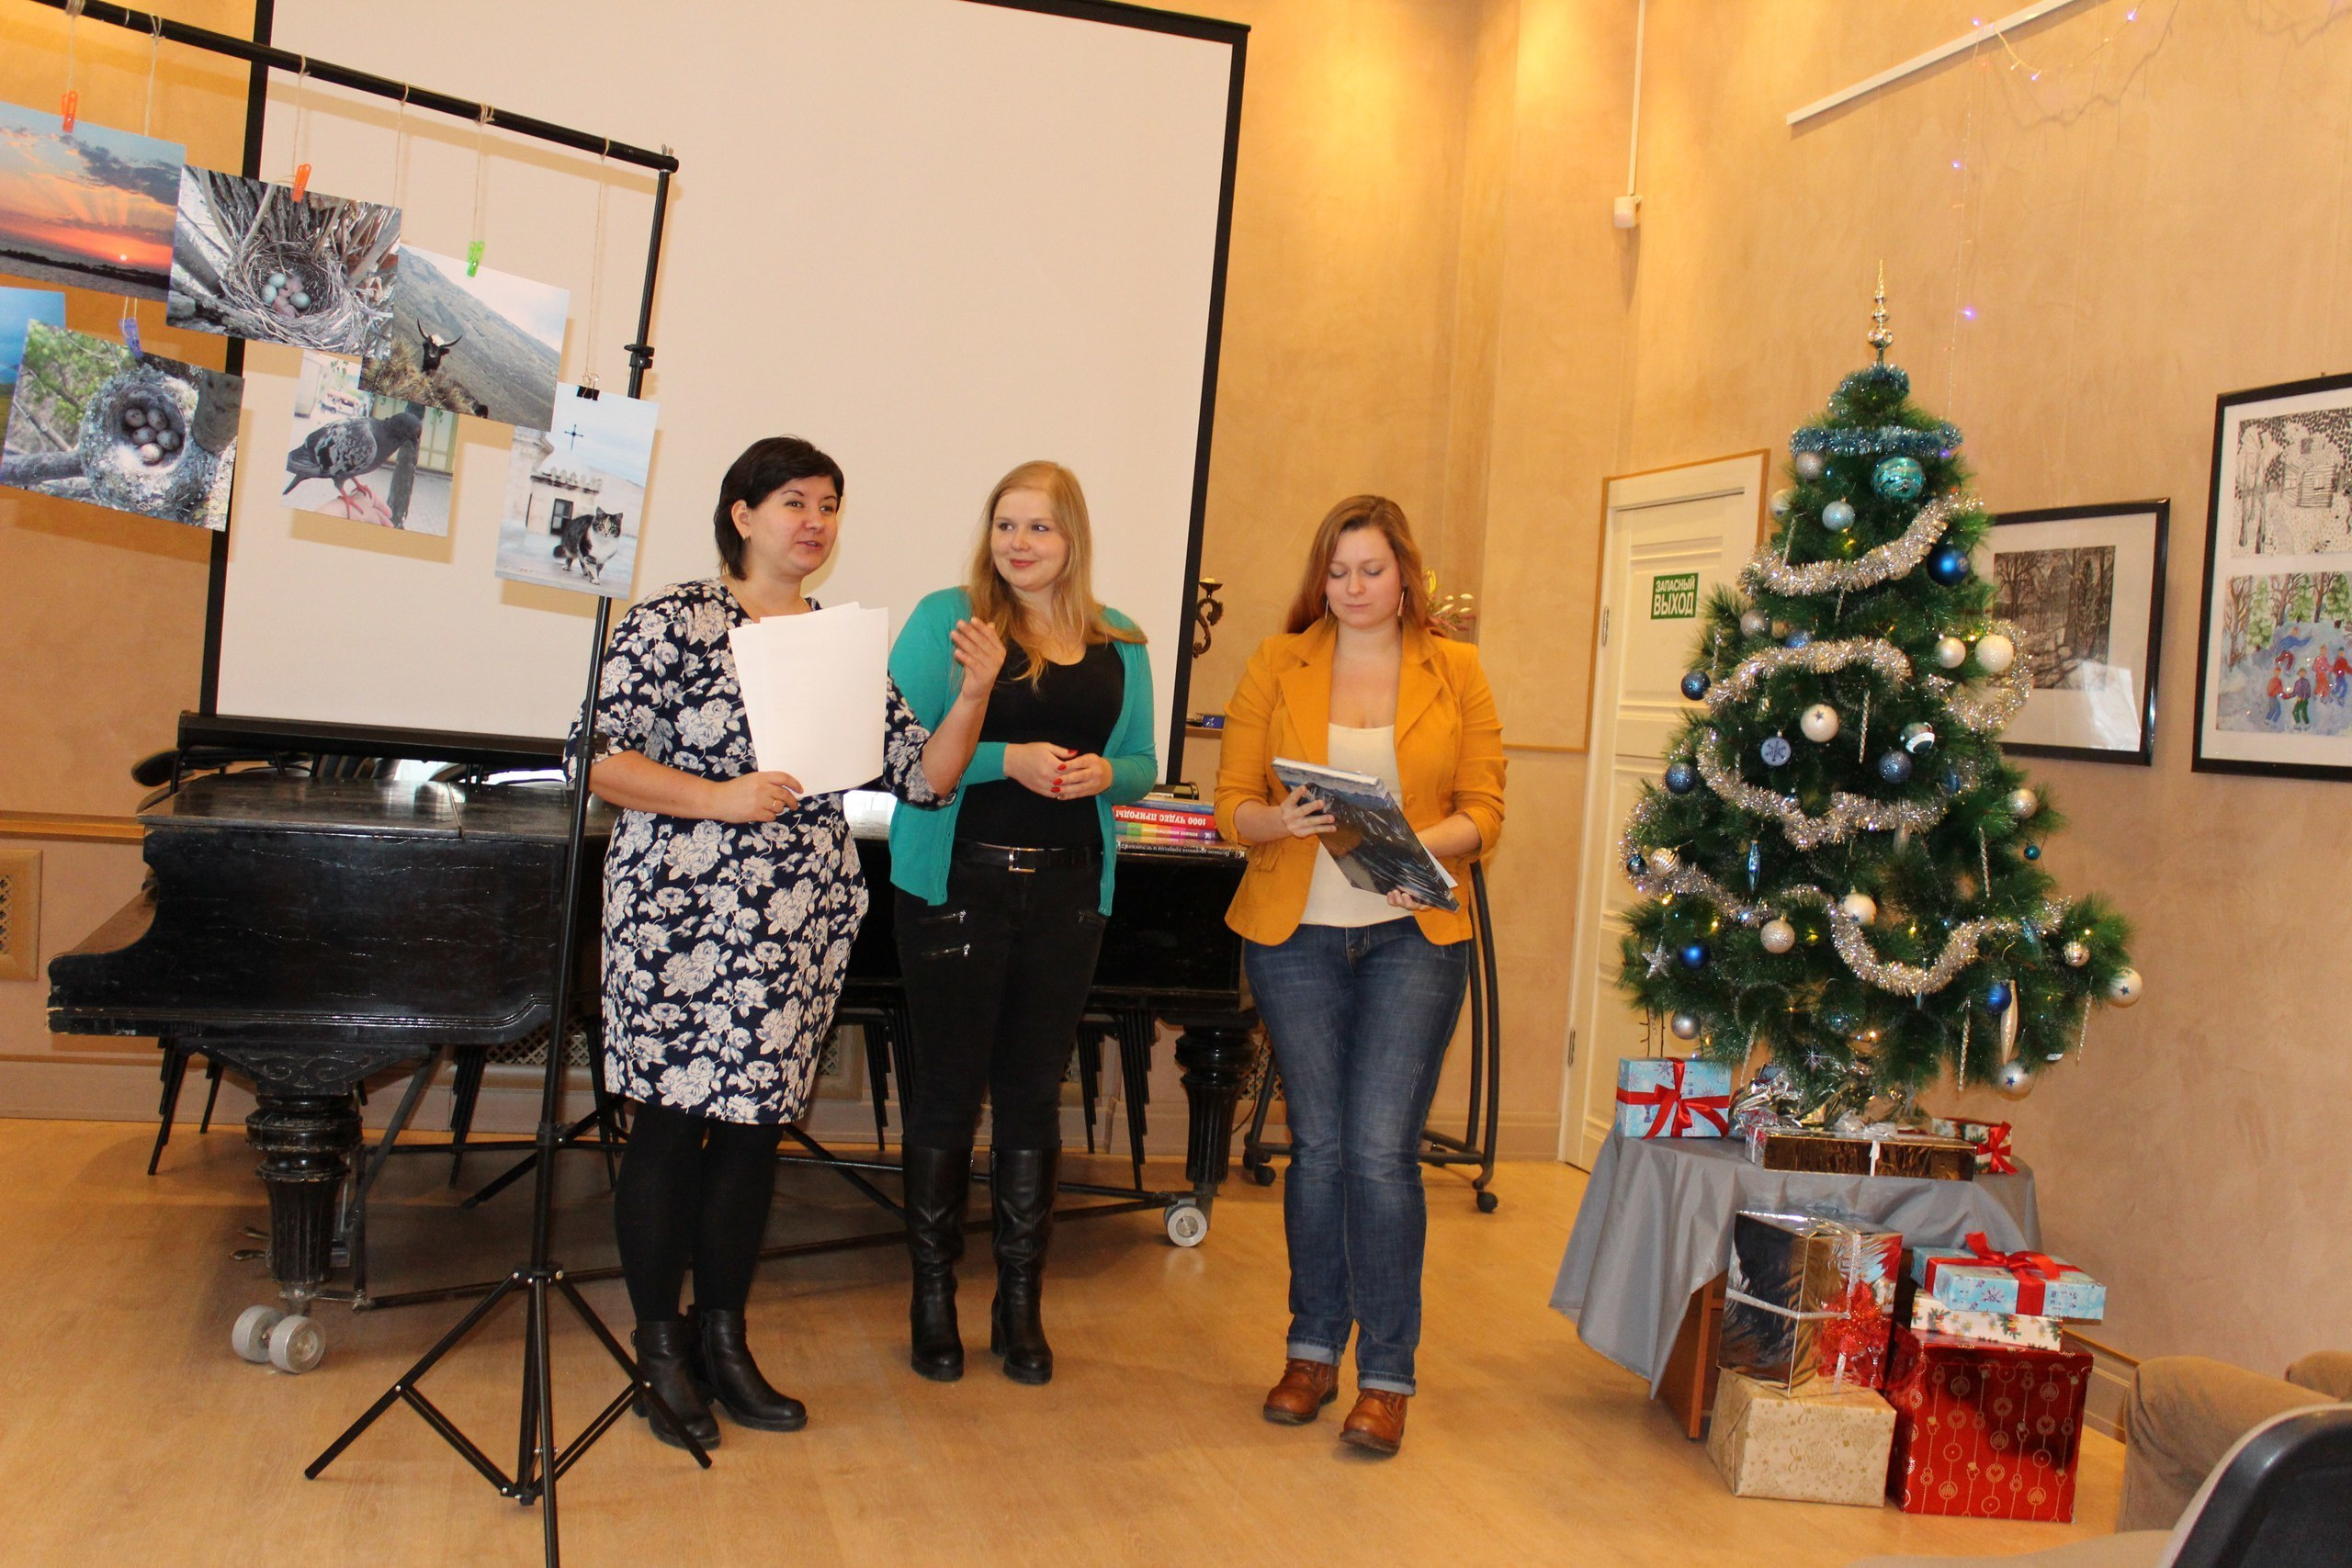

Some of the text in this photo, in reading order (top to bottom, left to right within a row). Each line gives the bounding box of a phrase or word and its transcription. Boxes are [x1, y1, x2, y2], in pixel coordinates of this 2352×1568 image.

[1656, 575, 1695, 592] ЗАПАСНЫЙ
[1653, 592, 1694, 615] ВЫХОД
[1115, 809, 1206, 827] 1000 ЧУДЕС ПРИРОДЫ
